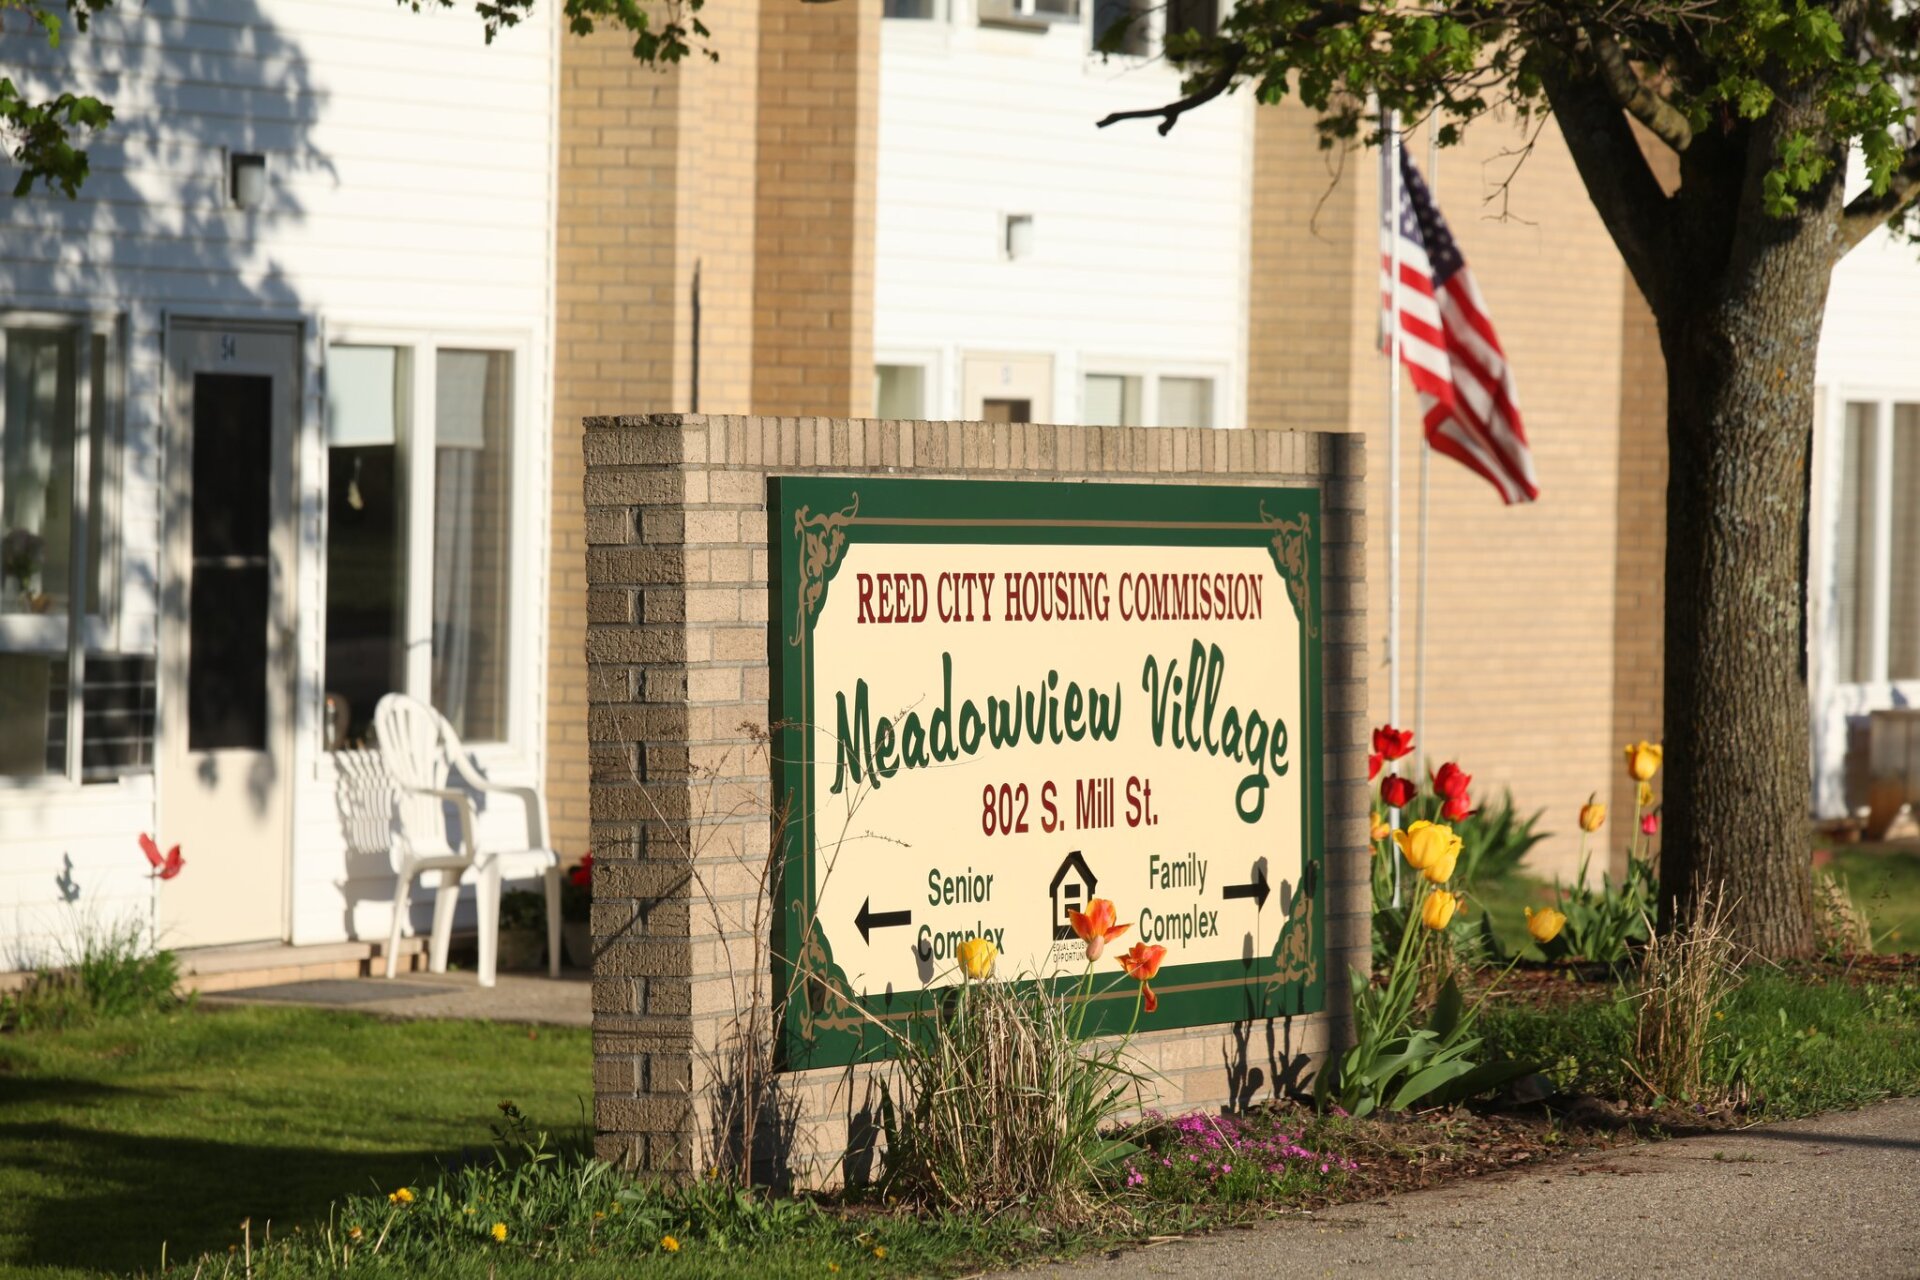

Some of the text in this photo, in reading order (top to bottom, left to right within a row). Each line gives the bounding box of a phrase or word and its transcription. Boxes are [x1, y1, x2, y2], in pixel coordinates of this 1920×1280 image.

[857, 571, 1263, 624] REED CITY HOUSING COMMISSION
[830, 638, 1289, 825] Meadowview Village
[982, 775, 1158, 837] 802 S. Mill St.
[928, 866, 993, 906] Senior
[1149, 852, 1208, 896] Family
[1139, 904, 1218, 950] Complex
[1053, 951, 1086, 963] OPPORTUN
